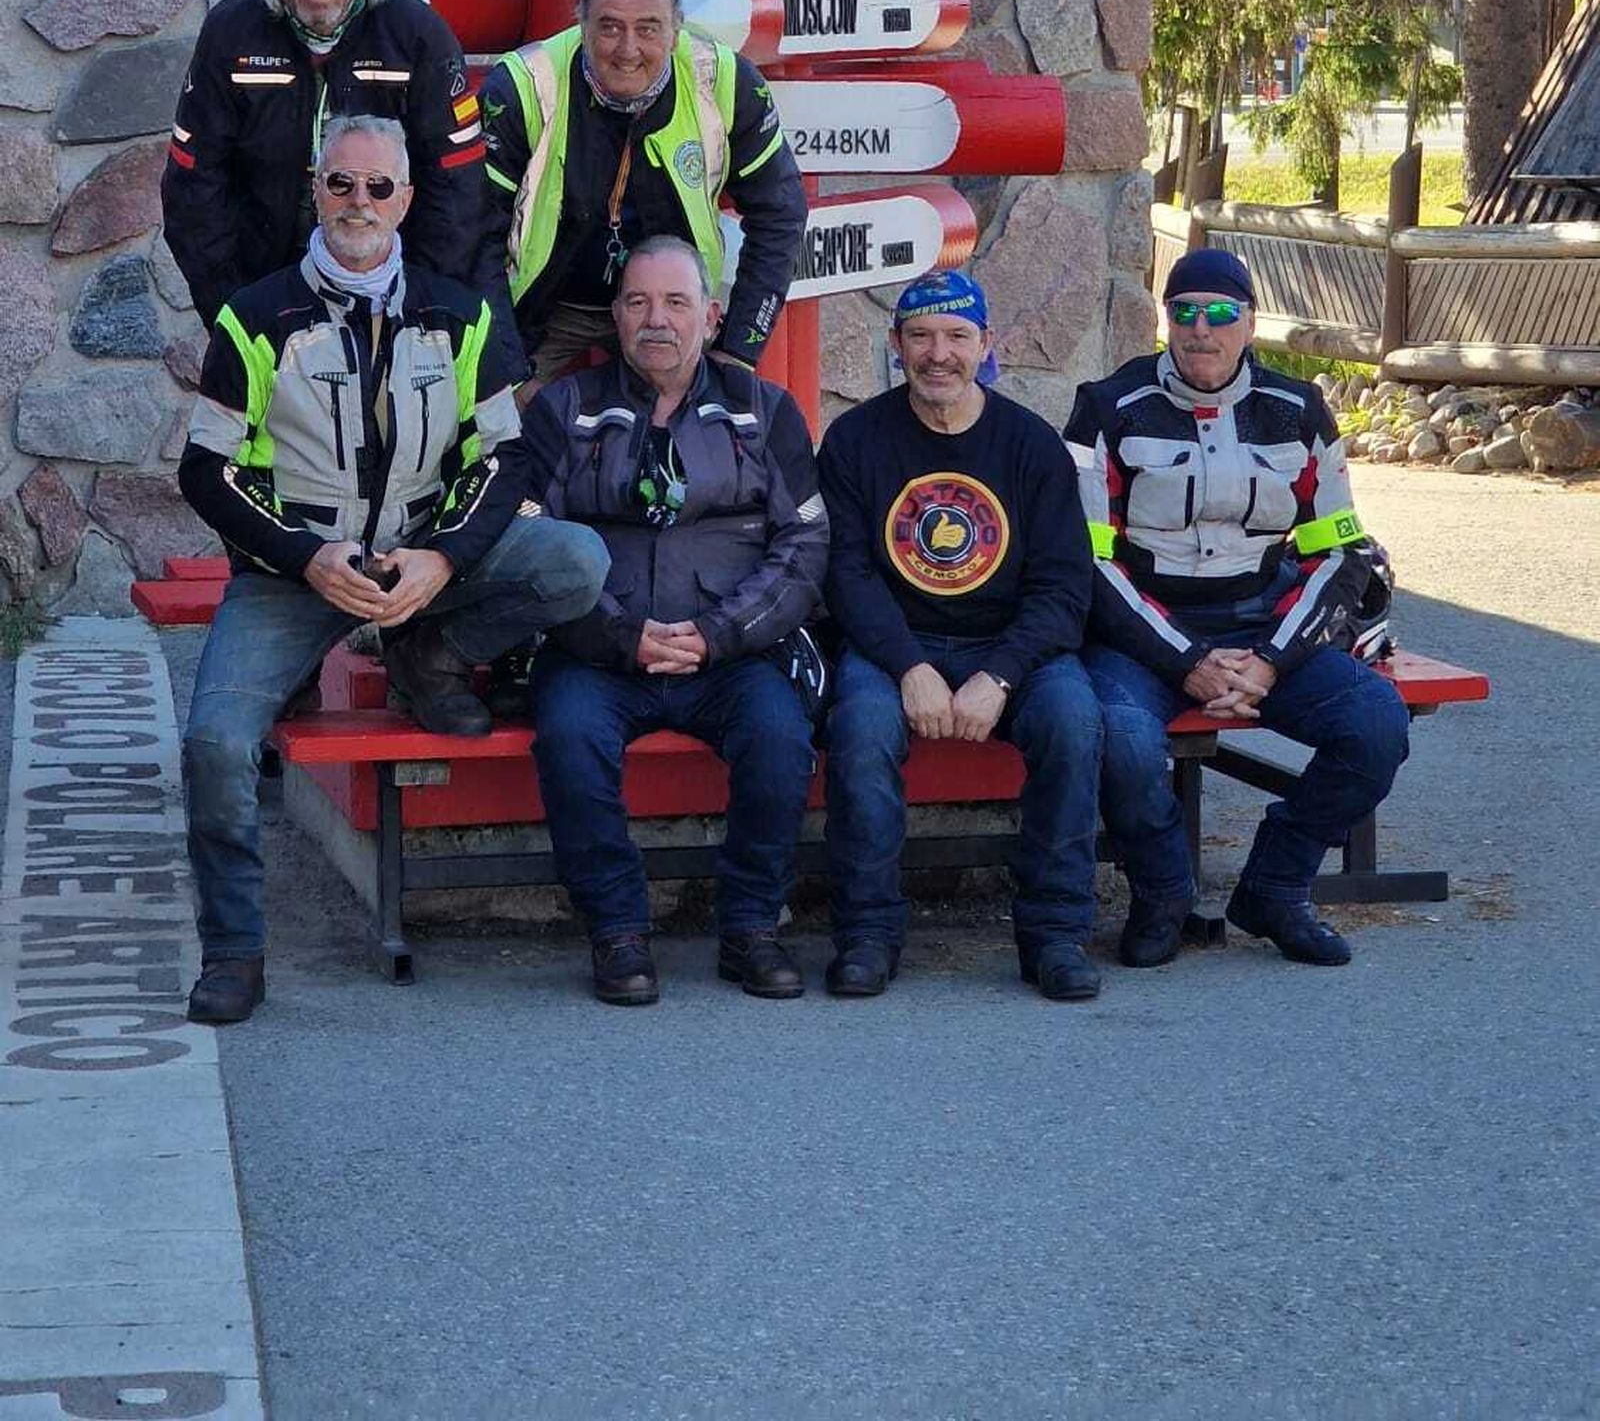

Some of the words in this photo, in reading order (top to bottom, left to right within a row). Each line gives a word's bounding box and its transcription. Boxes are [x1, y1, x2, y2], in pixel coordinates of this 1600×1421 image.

[249, 56, 282, 67] FELIPE
[794, 128, 891, 156] 2448KM
[29, 648, 160, 750] CIRCOLO
[20, 762, 190, 897] POLARE
[5, 914, 192, 1072] ARTICO
